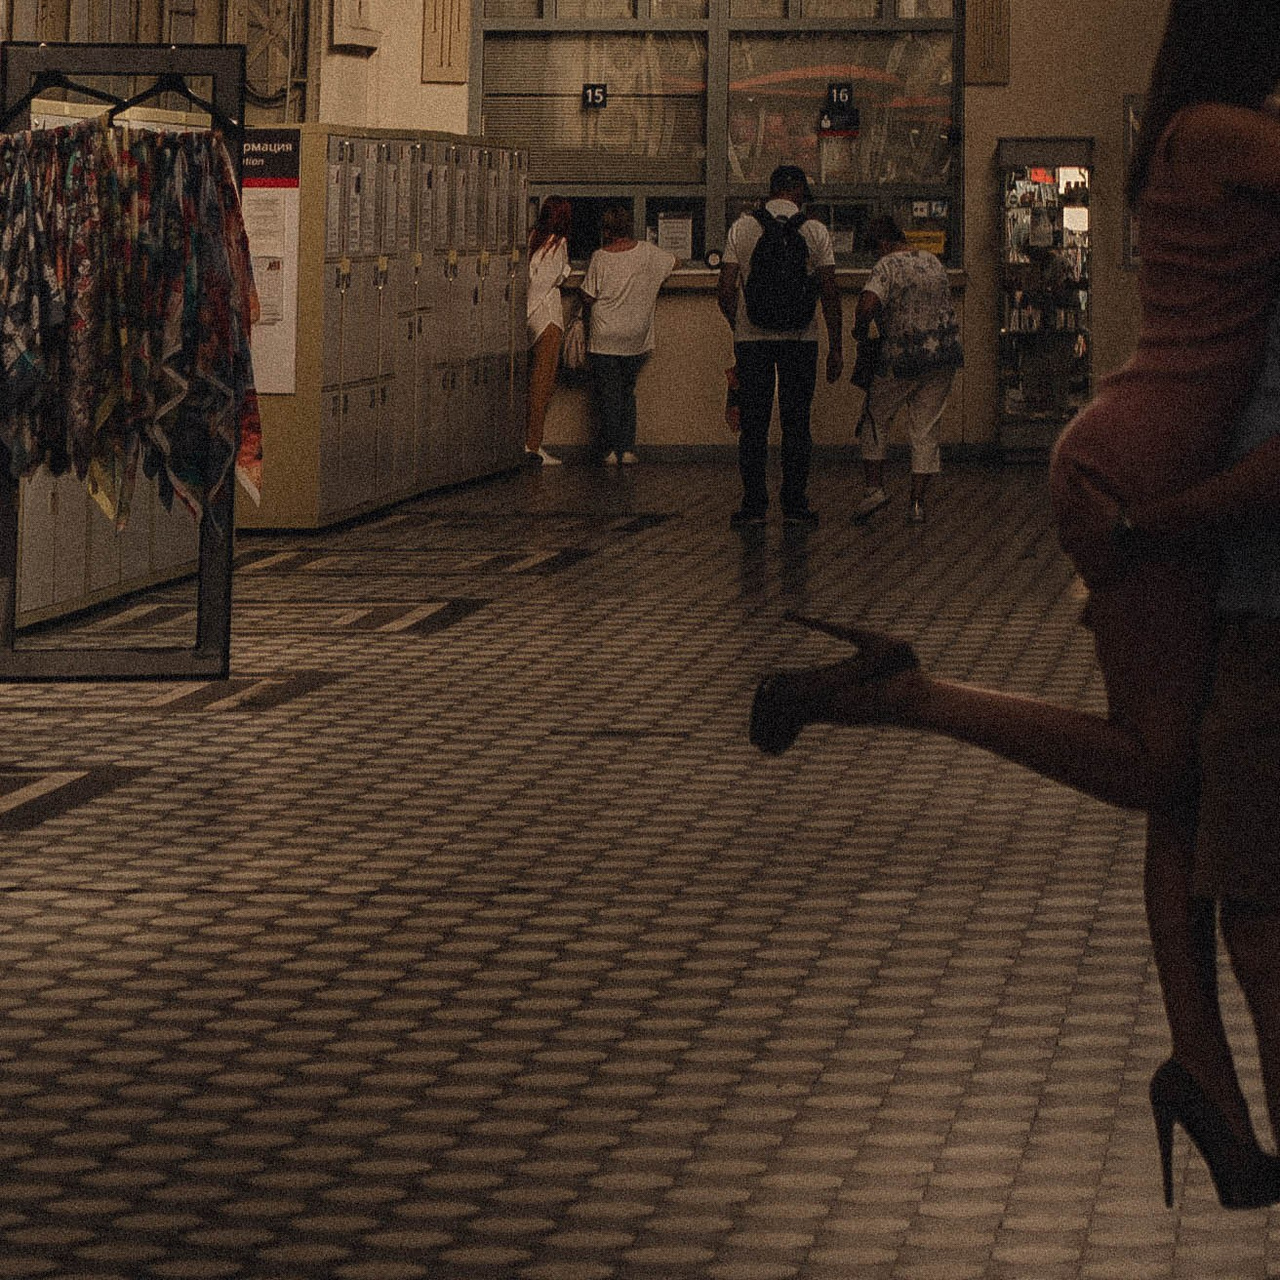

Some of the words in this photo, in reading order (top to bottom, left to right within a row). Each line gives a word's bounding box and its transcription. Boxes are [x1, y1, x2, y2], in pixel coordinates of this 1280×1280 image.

[586, 88, 604, 103] 15
[832, 87, 849, 103] 16
[243, 142, 293, 155] рмация
